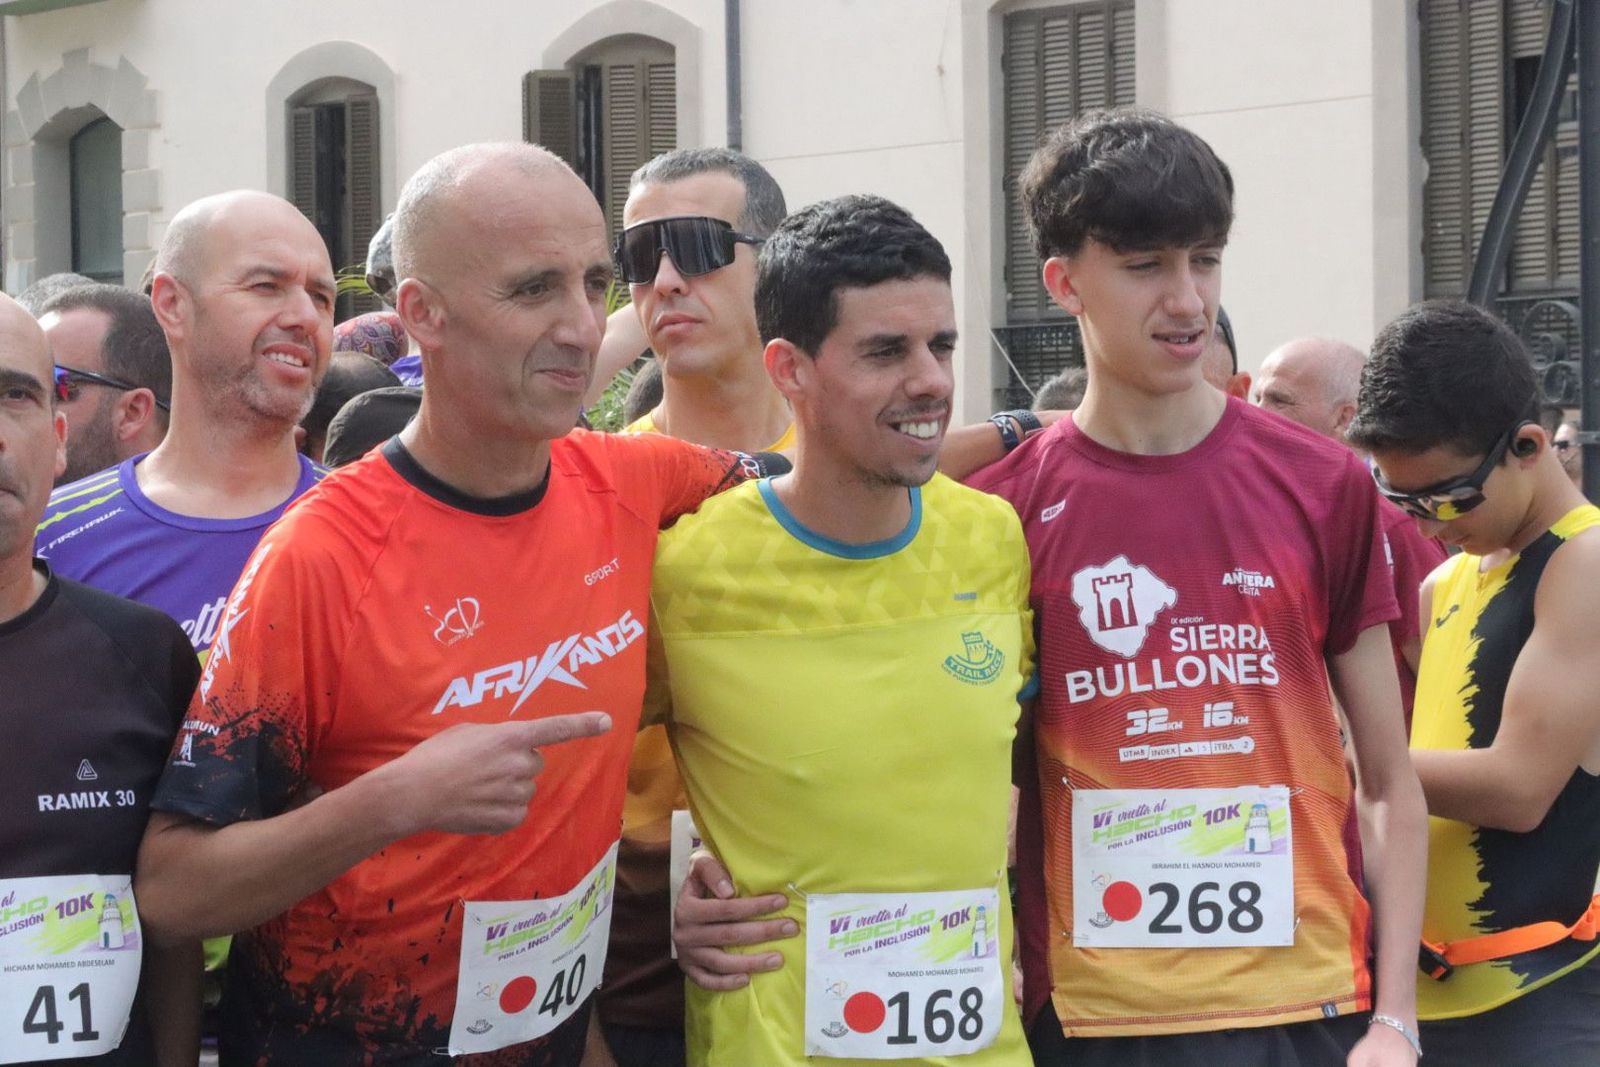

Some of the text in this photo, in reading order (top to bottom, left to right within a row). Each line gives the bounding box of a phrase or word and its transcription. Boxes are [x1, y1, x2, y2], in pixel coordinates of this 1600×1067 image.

[1222, 572, 1276, 588] ANTERA
[1169, 623, 1273, 653] SIERRA
[430, 609, 645, 717] AFRIKANOS
[1065, 652, 1280, 704] BULLONES
[1151, 748, 1177, 757] INDEX
[38, 790, 135, 812] RAMIX 30
[1118, 803, 1151, 823] vuelta
[1154, 799, 1167, 812] al
[1203, 803, 1241, 826] 10K
[1124, 838, 1134, 846] LA
[1136, 819, 1192, 842] INCLUSIÓN
[55, 892, 94, 919] 10K
[856, 909, 892, 929] vuelta
[894, 903, 909, 918] al
[940, 907, 971, 931] 10K
[1148, 881, 1264, 935] 268
[36, 961, 76, 970] MOHAMED
[538, 954, 587, 1017] 40
[23, 982, 99, 1044] 41
[887, 986, 984, 1046] 168
